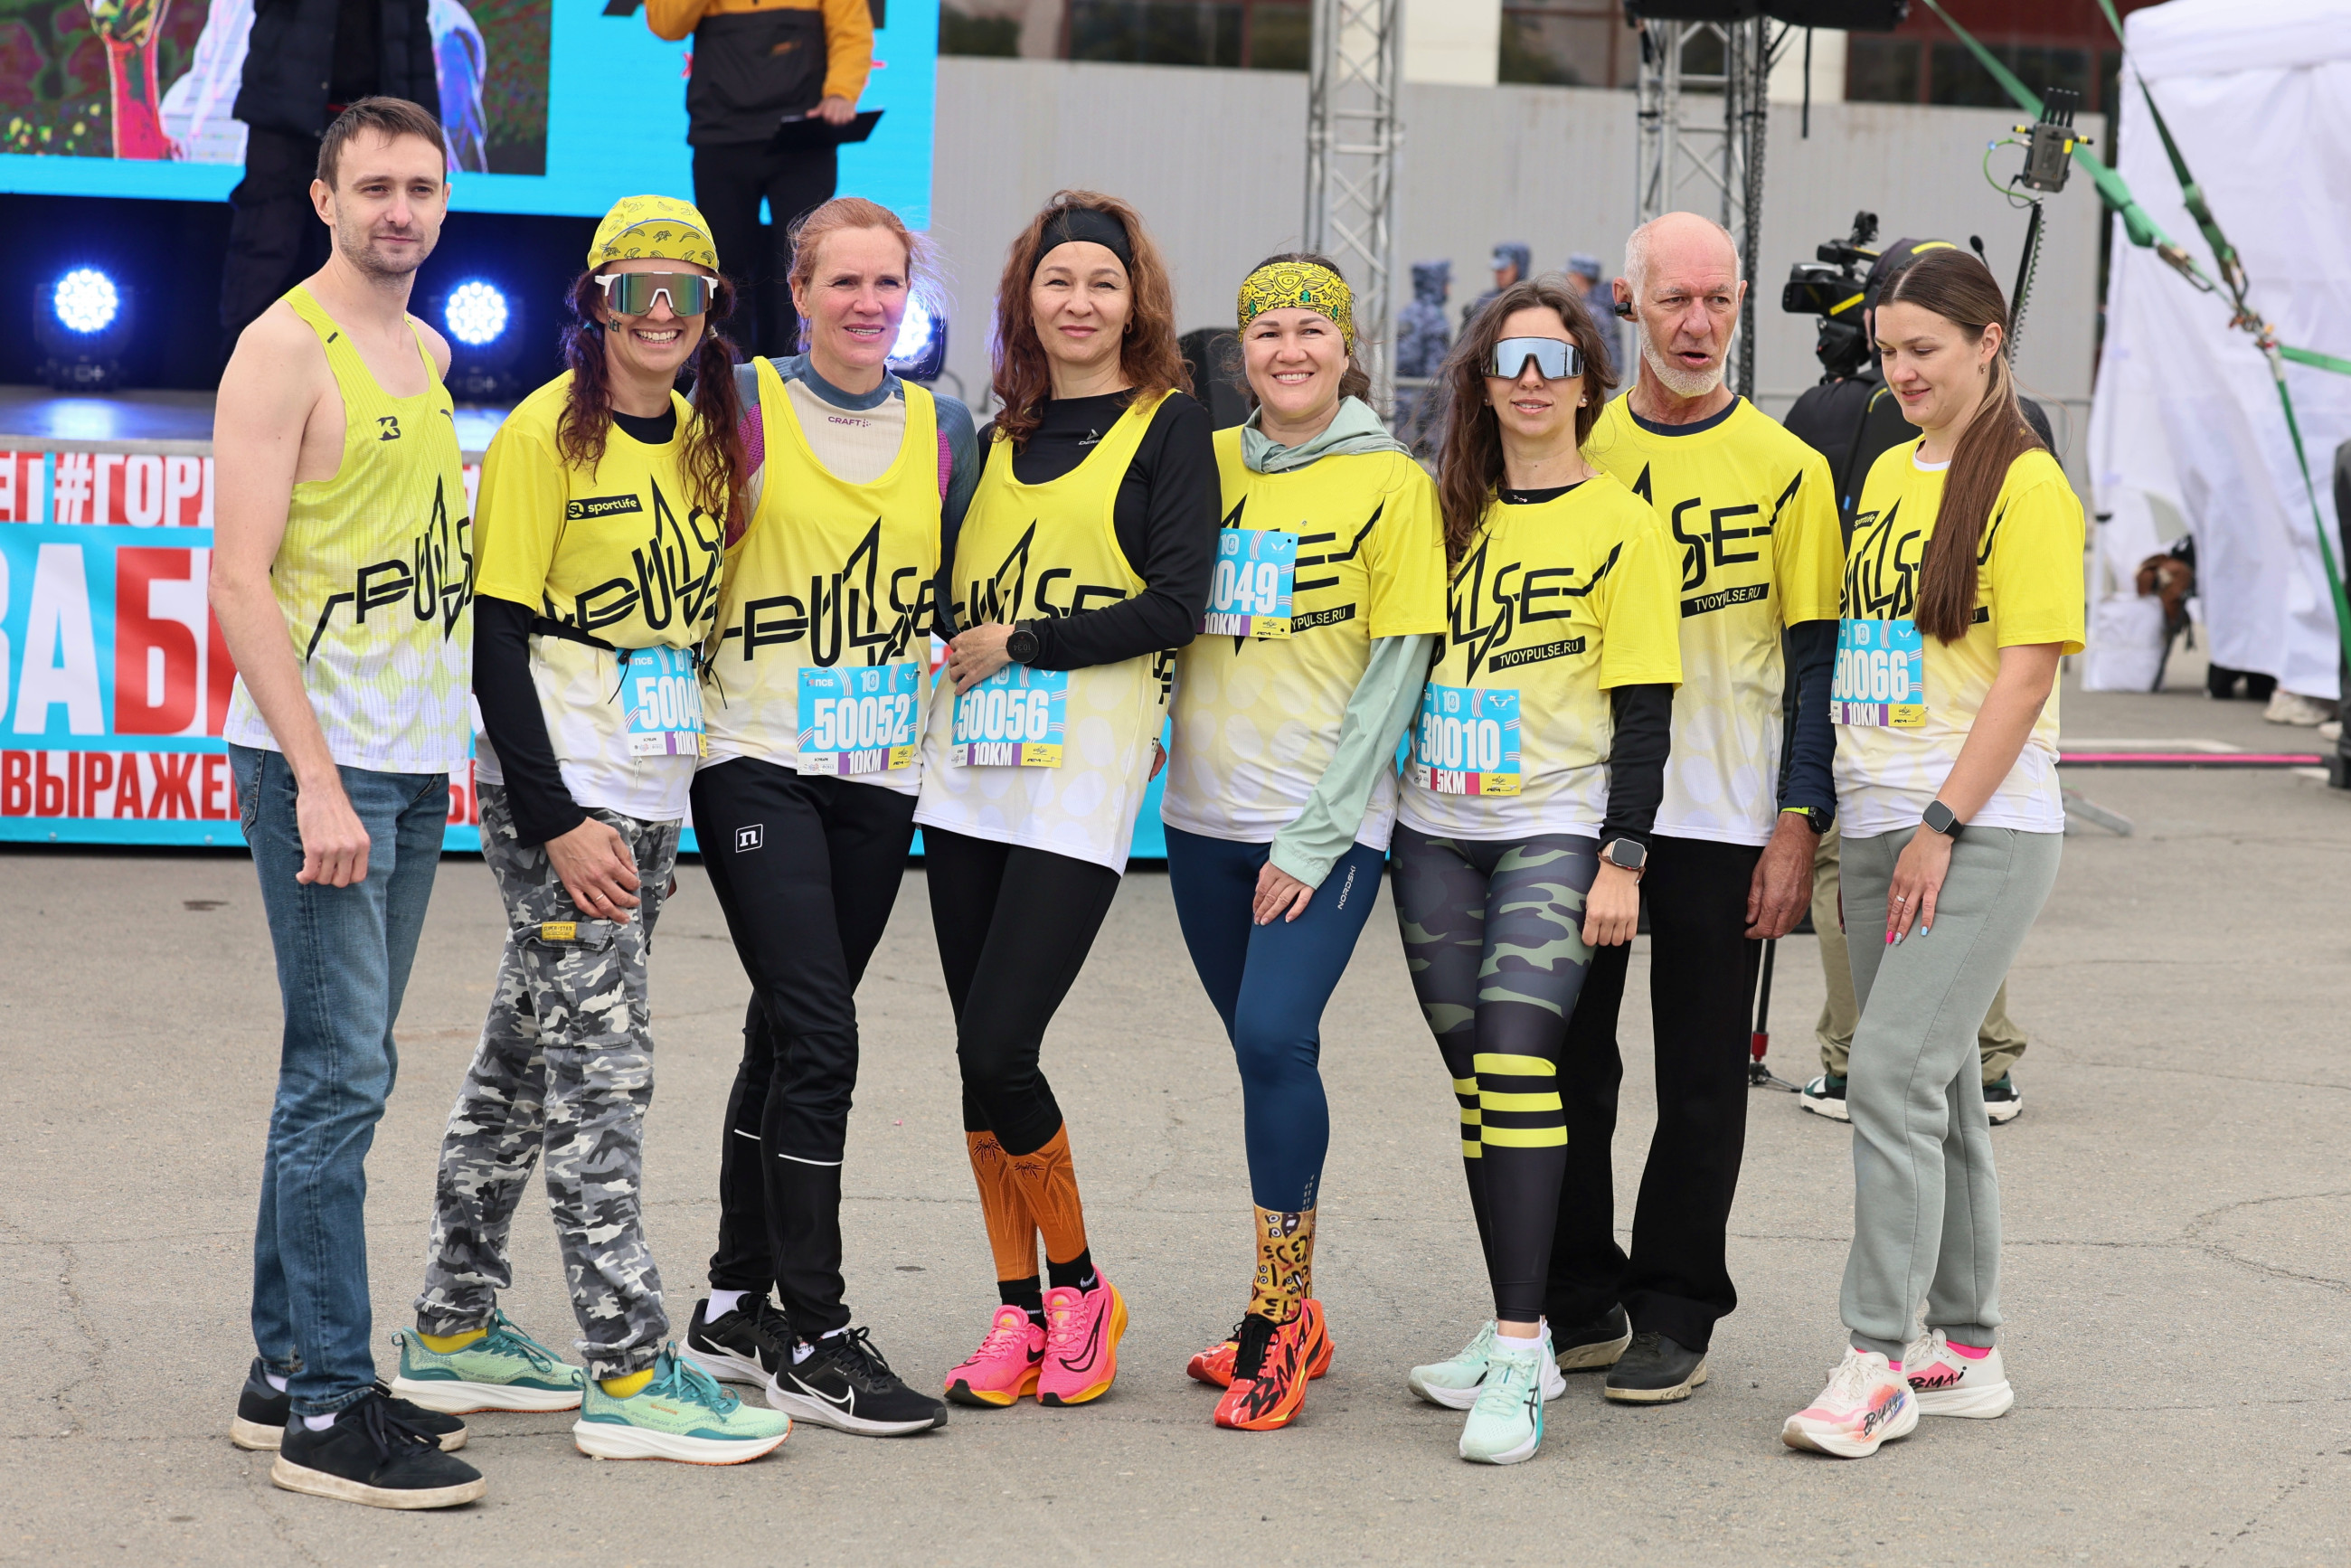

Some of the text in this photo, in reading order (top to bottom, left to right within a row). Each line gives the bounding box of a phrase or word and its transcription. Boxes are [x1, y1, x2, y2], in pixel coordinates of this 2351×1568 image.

[827, 416, 862, 427] CRAFT
[588, 498, 637, 515] sportlife
[1204, 612, 1241, 635] 10KM
[1291, 608, 1346, 630] YPULSE.RU
[635, 657, 653, 666] ПСБ
[1499, 640, 1580, 667] TVOYPULSE.RU
[815, 679, 834, 687] ПСБ
[1834, 648, 1909, 701] 50066
[814, 694, 911, 750] 50052
[958, 689, 1049, 741] 50056
[1847, 703, 1880, 726] 10KM
[974, 742, 1013, 766] 10KM
[1421, 713, 1500, 770] 30010
[847, 749, 883, 775] 10KM
[2, 750, 241, 821] ВЫРАЖЕ
[1436, 770, 1466, 795] 5KM
[1337, 864, 1356, 910] NORDSKI
